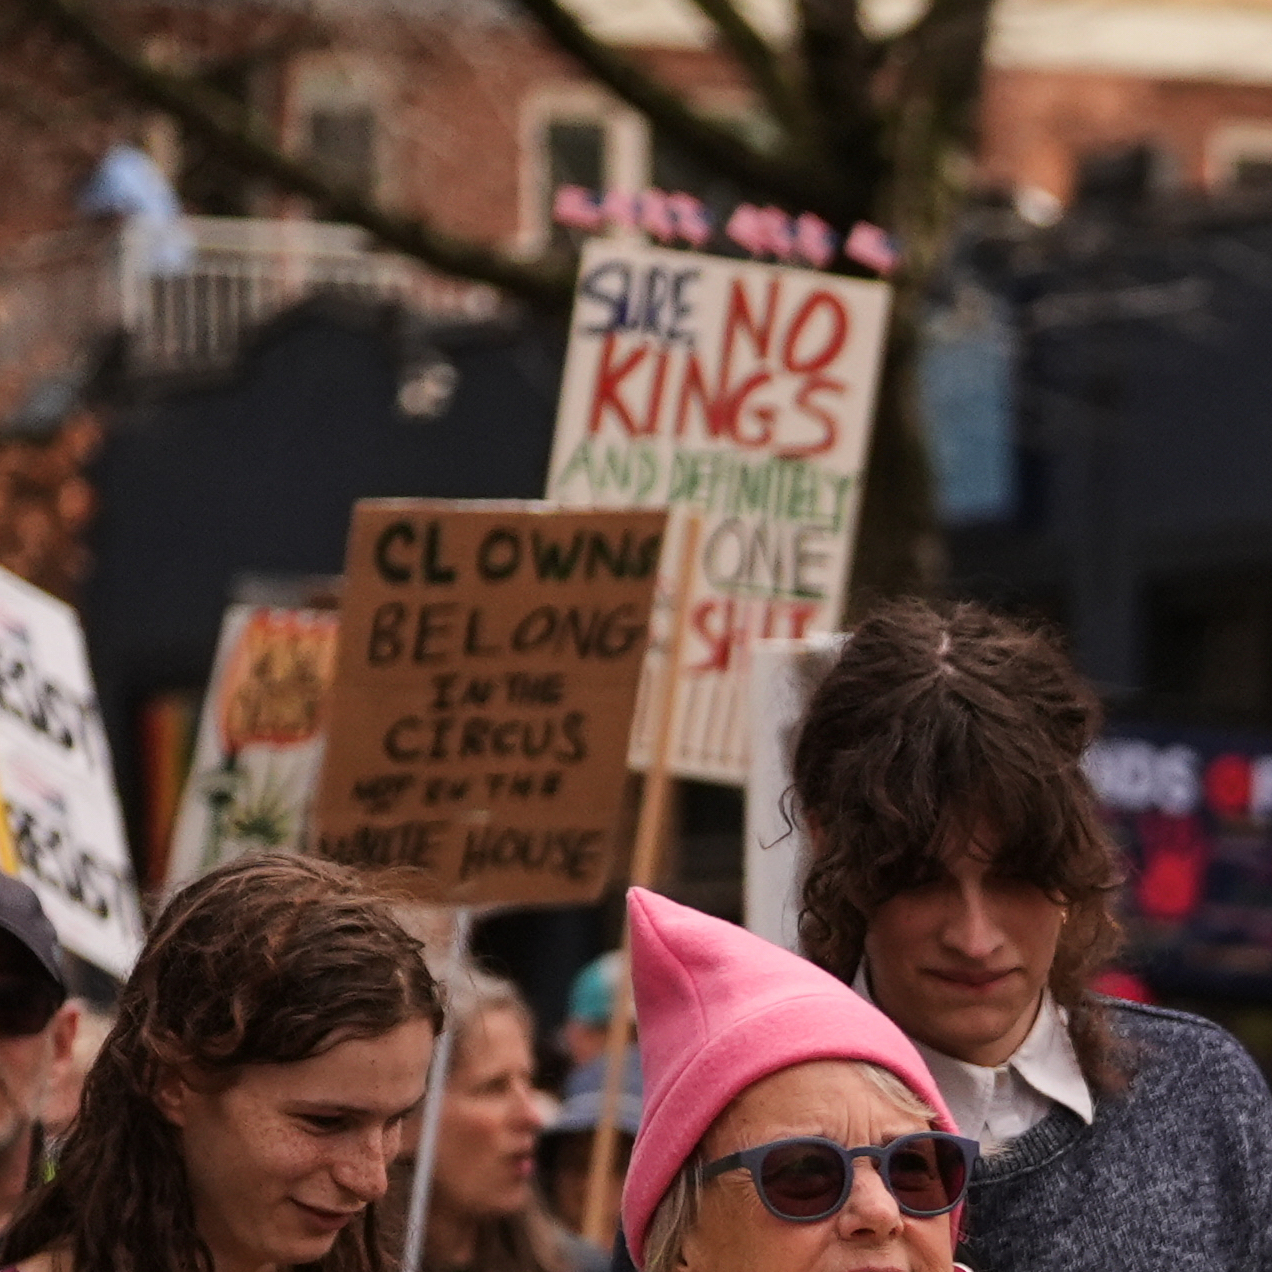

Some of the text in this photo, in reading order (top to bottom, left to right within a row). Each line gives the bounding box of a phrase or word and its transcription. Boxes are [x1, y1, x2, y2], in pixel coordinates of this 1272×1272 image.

[720, 274, 848, 396] NO
[587, 332, 846, 460] KINGS
[557, 442, 659, 498] AND
[367, 601, 648, 667] BELONG
[432, 671, 566, 712] IN THE
[382, 710, 587, 764] CIRCUS
[460, 828, 601, 880] HOUSE
